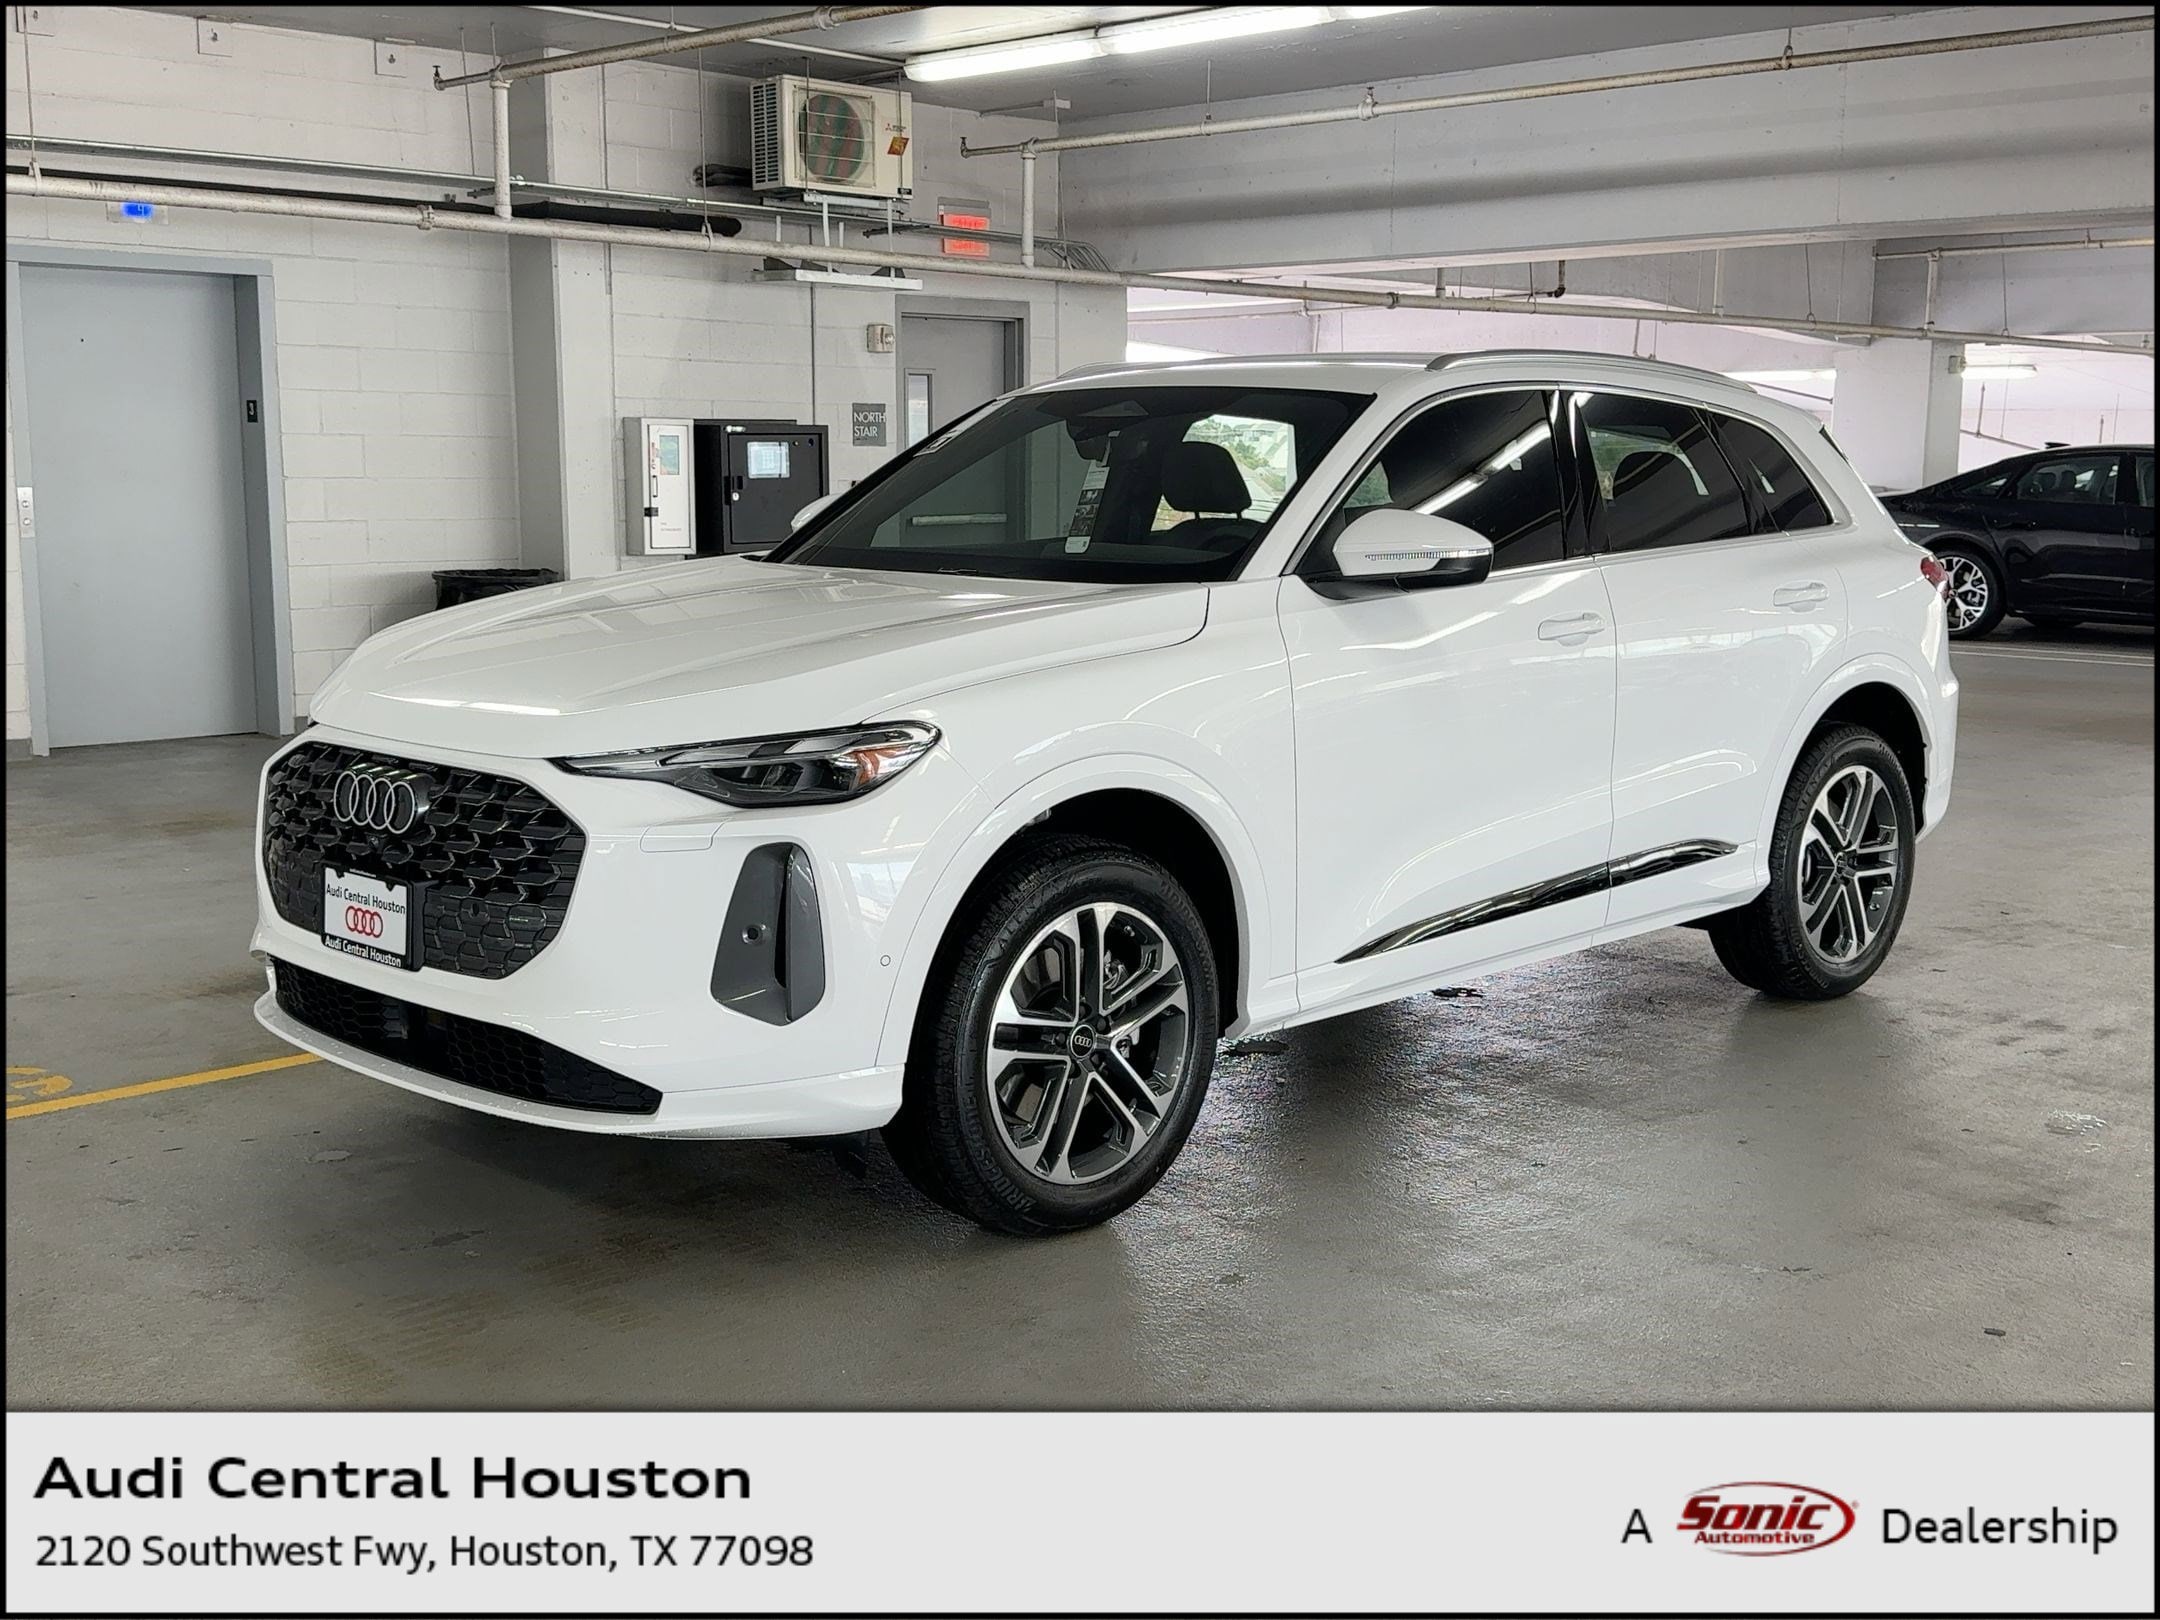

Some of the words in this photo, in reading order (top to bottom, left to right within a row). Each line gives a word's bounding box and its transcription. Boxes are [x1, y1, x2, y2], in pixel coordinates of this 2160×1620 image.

[853, 411, 886, 423] NORTH
[854, 425, 878, 437] STAIR
[326, 883, 343, 898] Audi
[344, 889, 370, 906] Central
[372, 895, 406, 915] Houston
[325, 935, 342, 950] Audi
[342, 940, 369, 958] Central
[370, 947, 401, 968] Houston
